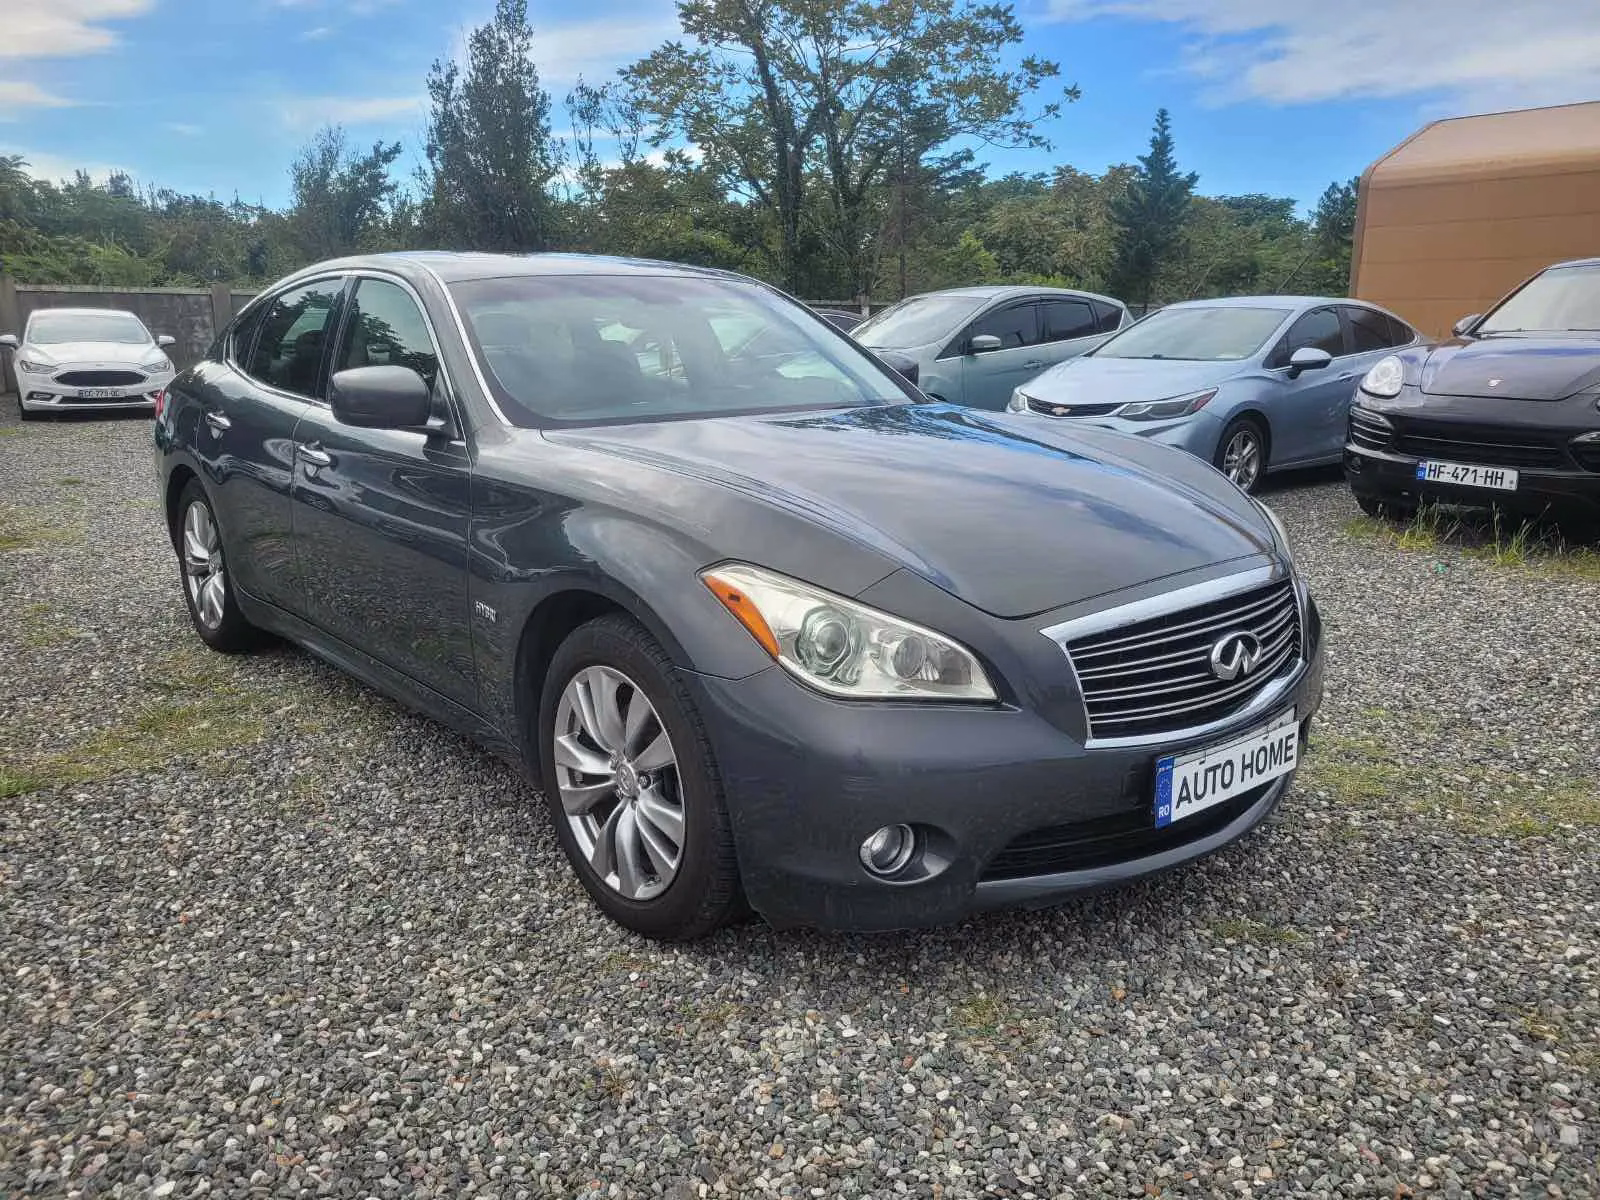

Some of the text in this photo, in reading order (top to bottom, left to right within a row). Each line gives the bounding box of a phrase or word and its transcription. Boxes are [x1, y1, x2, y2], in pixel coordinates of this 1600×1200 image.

[1427, 464, 1505, 487] HF-471-HH
[1176, 732, 1295, 809] AUTO HOME
[1158, 804, 1170, 818] RO
